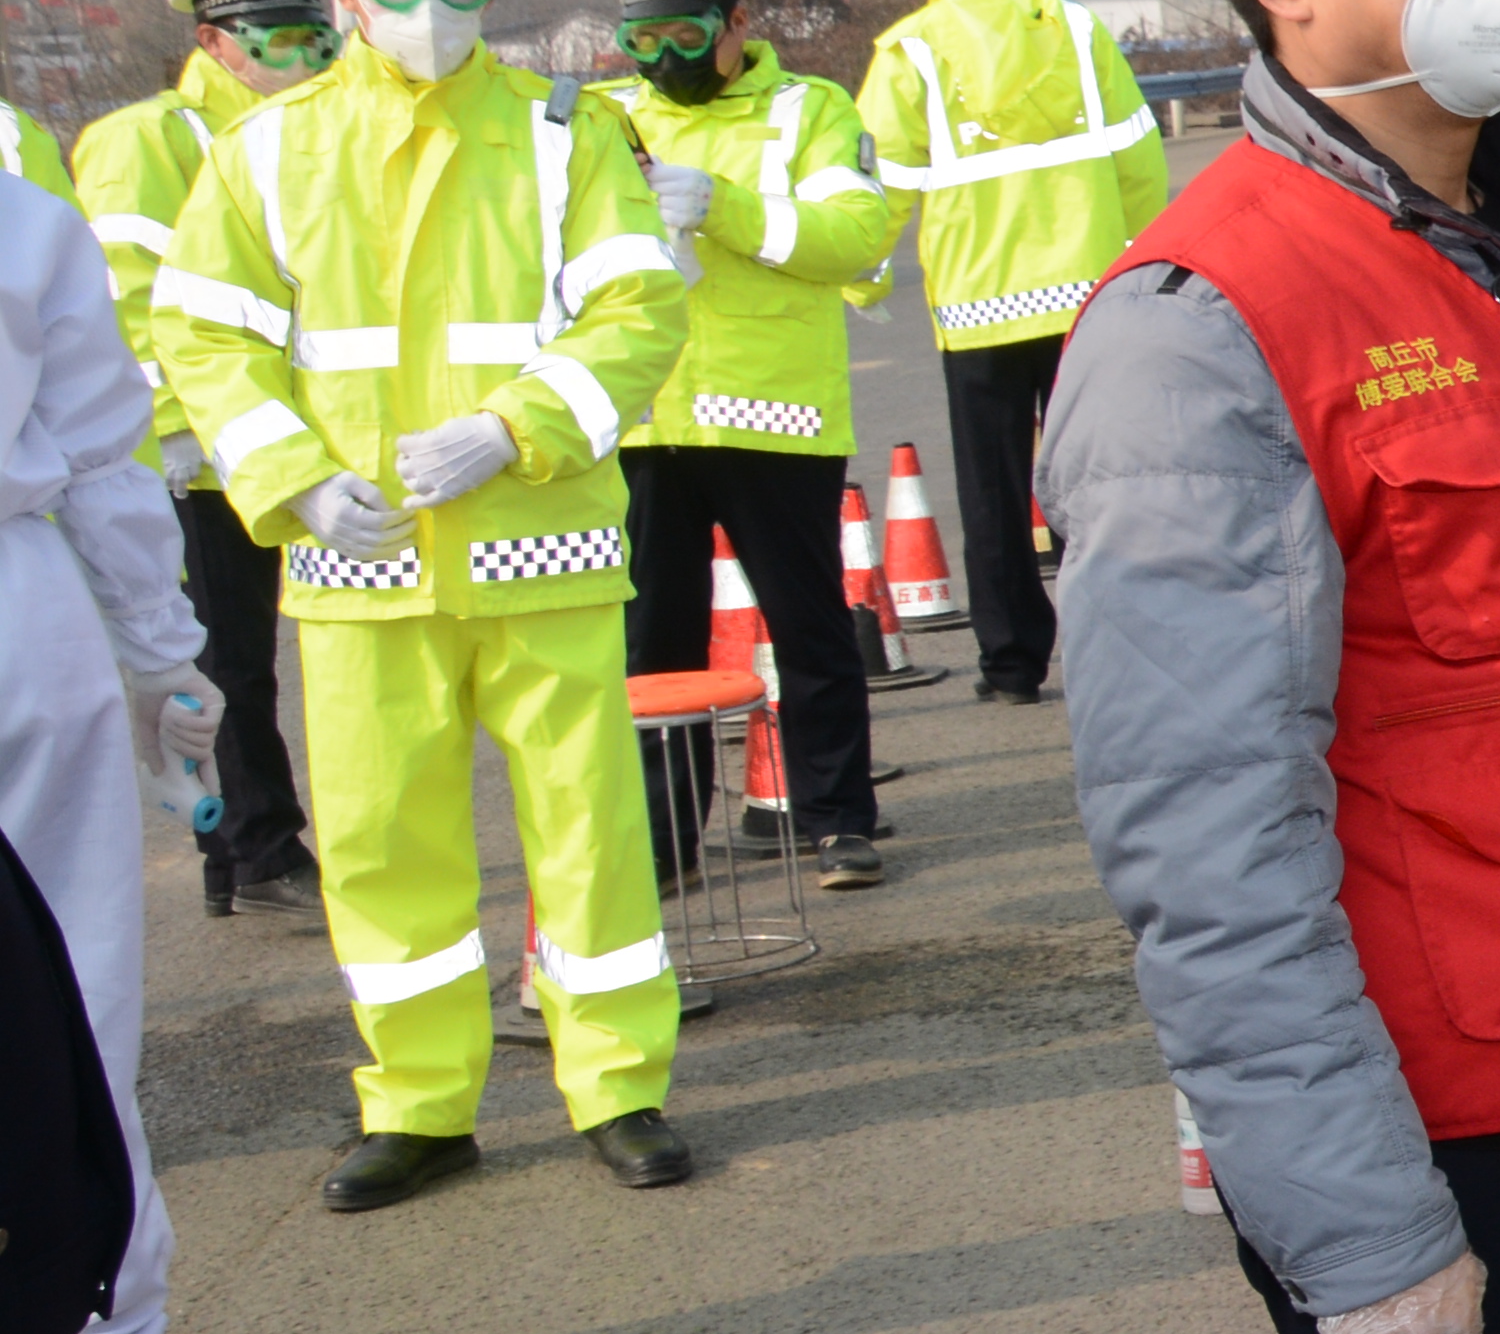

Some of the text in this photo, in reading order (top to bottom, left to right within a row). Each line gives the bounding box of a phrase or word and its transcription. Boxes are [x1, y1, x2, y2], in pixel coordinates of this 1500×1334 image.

[1364, 336, 1441, 370] 商丘市
[1355, 355, 1480, 411] 博爱联合会
